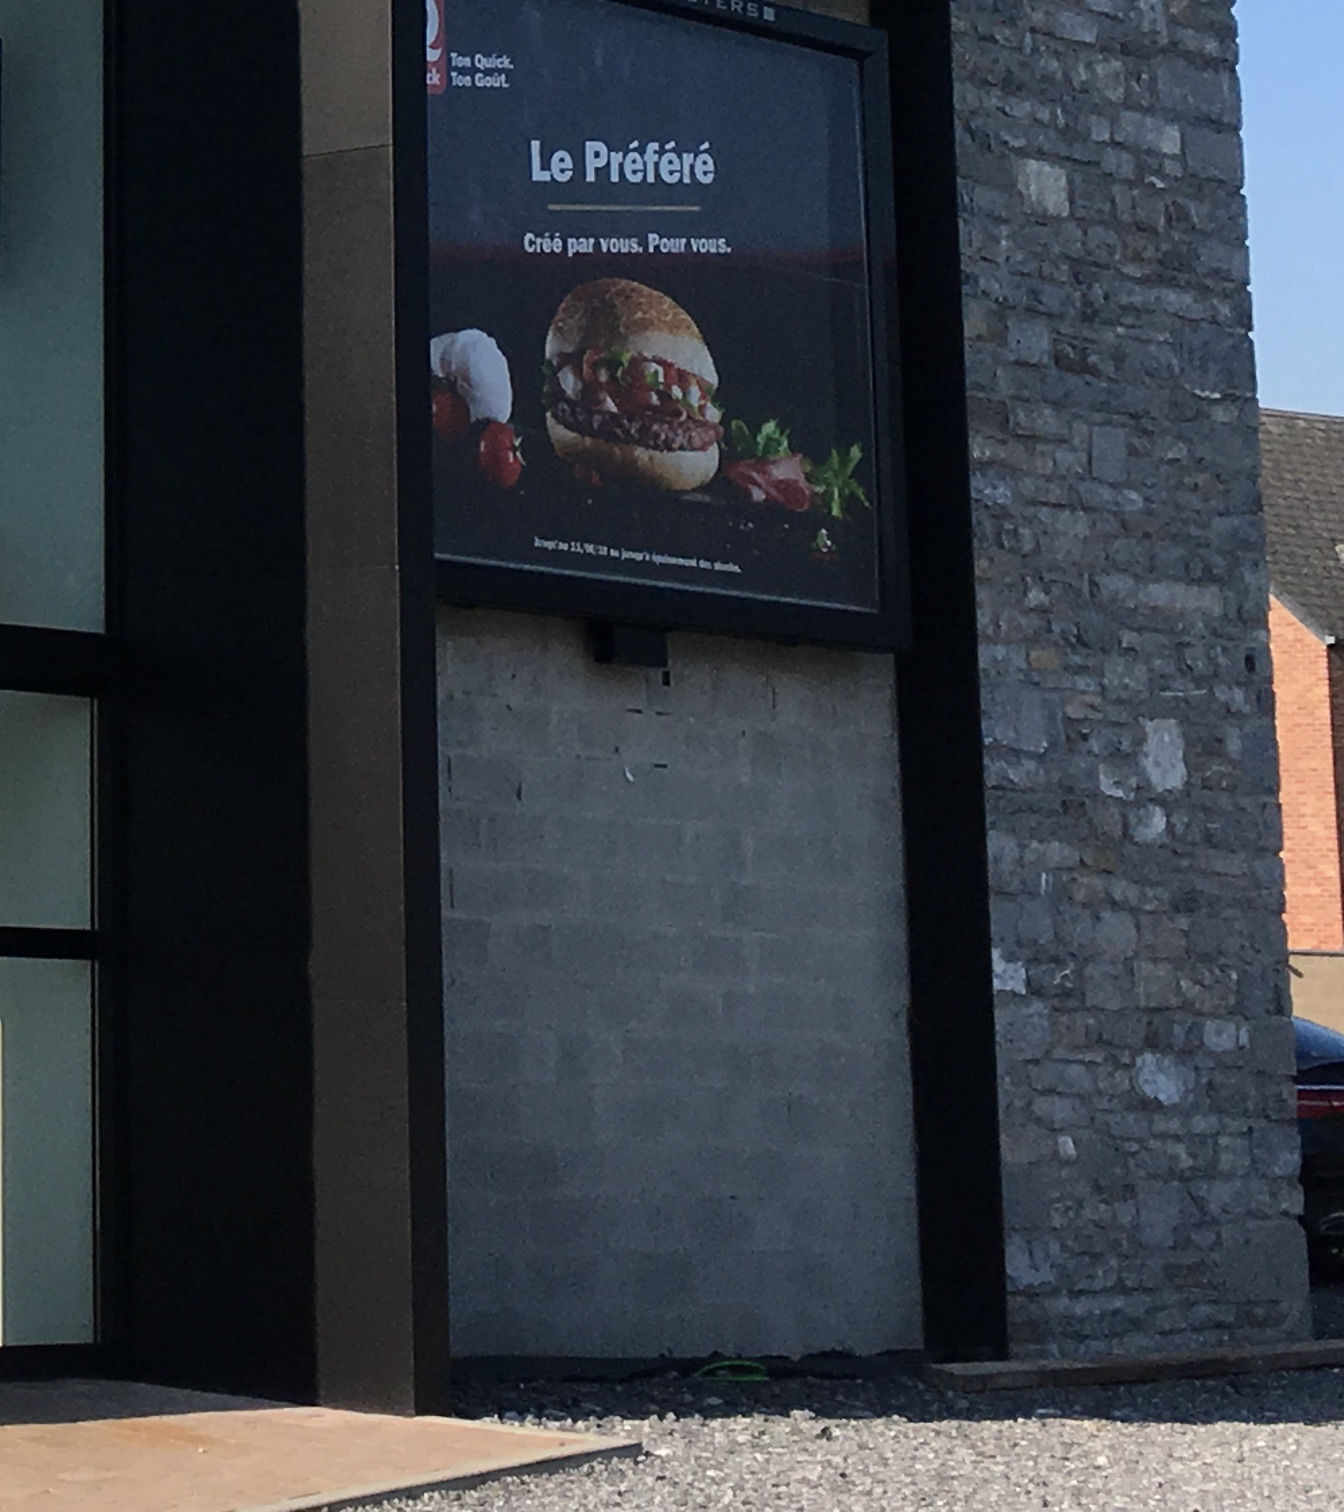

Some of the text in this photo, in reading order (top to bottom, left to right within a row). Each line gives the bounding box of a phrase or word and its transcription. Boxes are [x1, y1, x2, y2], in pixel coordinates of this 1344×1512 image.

[474, 53, 514, 70] Quick.
[530, 140, 716, 185] Le Préféré
[524, 232, 732, 257] Créé par vous. Pour vous.
